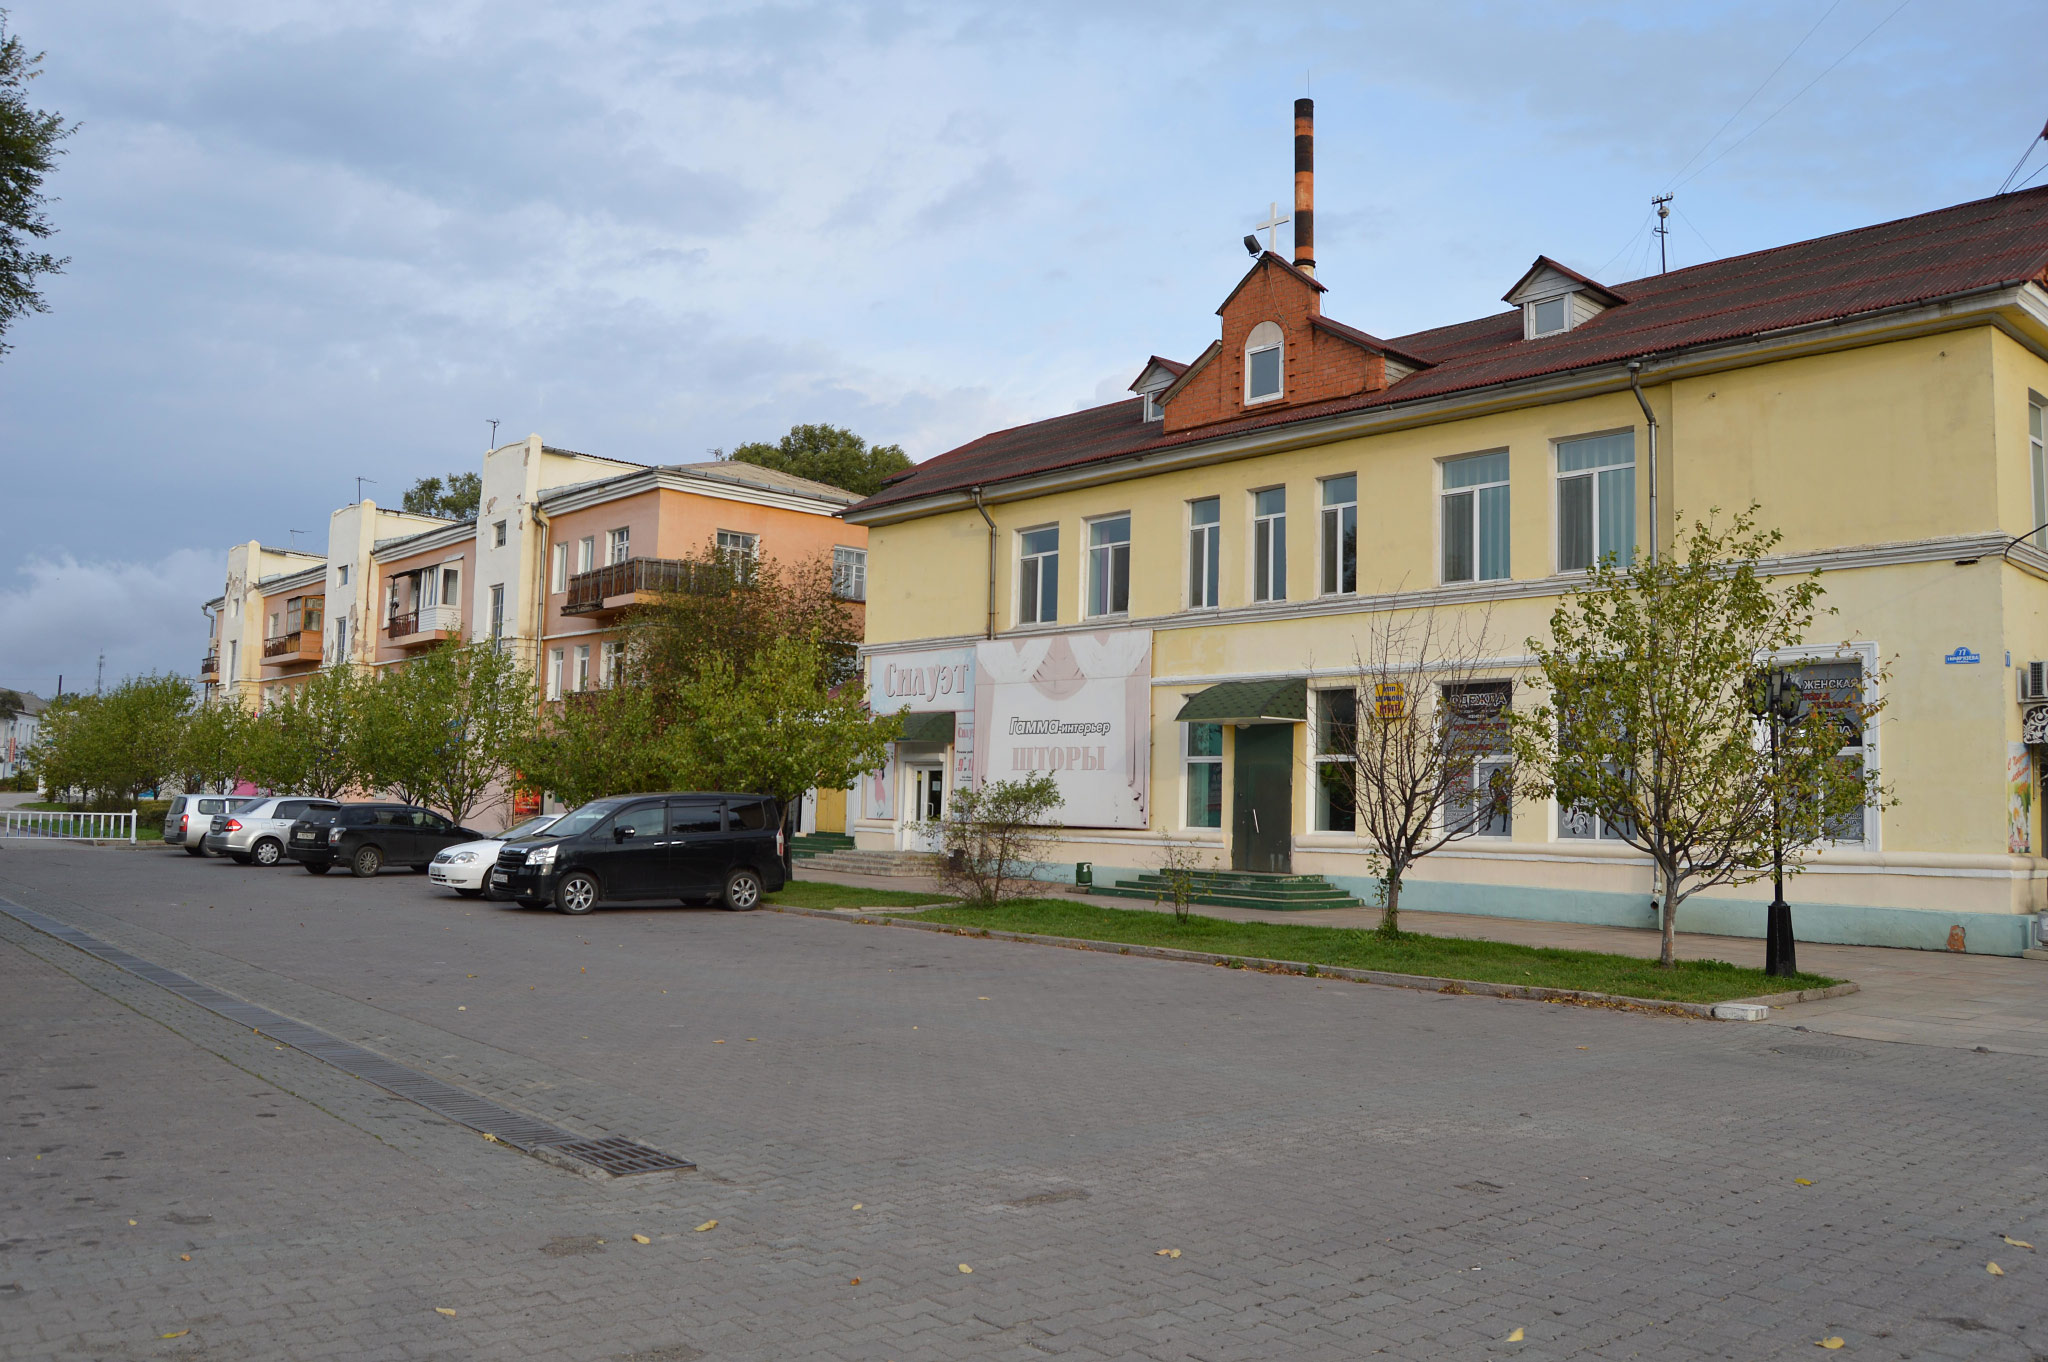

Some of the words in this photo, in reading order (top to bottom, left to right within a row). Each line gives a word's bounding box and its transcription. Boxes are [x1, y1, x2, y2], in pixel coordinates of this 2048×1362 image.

[884, 663, 969, 702] Силуэт
[1803, 677, 1859, 690] ЖЕНСКАЯ
[1008, 716, 1111, 736] Гамма-интерьер
[1011, 746, 1107, 771] ШТОРЫ
